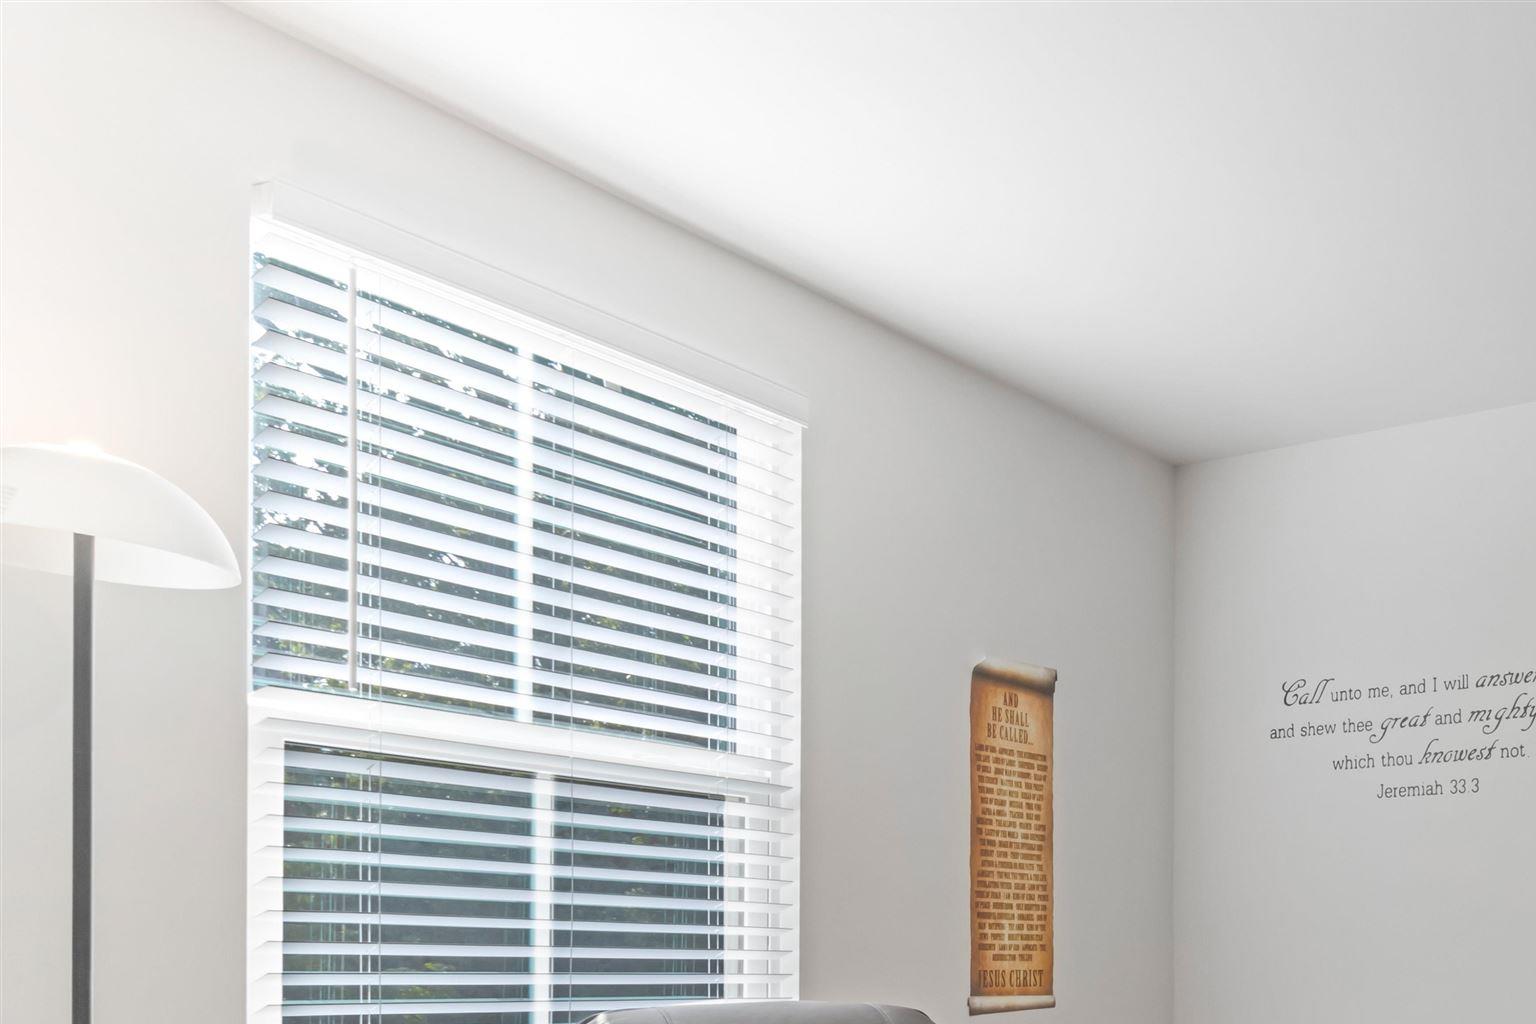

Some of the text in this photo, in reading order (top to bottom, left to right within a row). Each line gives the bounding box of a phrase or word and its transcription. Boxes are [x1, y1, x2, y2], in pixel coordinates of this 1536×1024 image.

[1003, 691, 1019, 709] AND
[1281, 678, 1335, 707] Call
[1331, 687, 1362, 703] unto
[1368, 685, 1393, 700] me,
[1399, 678, 1427, 696] and
[1432, 677, 1439, 693] I
[1444, 674, 1470, 690] will
[992, 705, 1030, 728] HE SHALL
[1269, 722, 1295, 740] and
[1300, 720, 1336, 738] shew
[1342, 717, 1374, 734] thee
[1369, 706, 1435, 744] great
[1434, 708, 1462, 726] and
[986, 722, 997, 739] BE
[1332, 753, 1376, 772] which
[1381, 751, 1413, 769] thou
[1417, 738, 1500, 765] knowest
[1376, 780, 1443, 800] Jeremiah
[977, 969, 1044, 989] JESUS CHRIST
